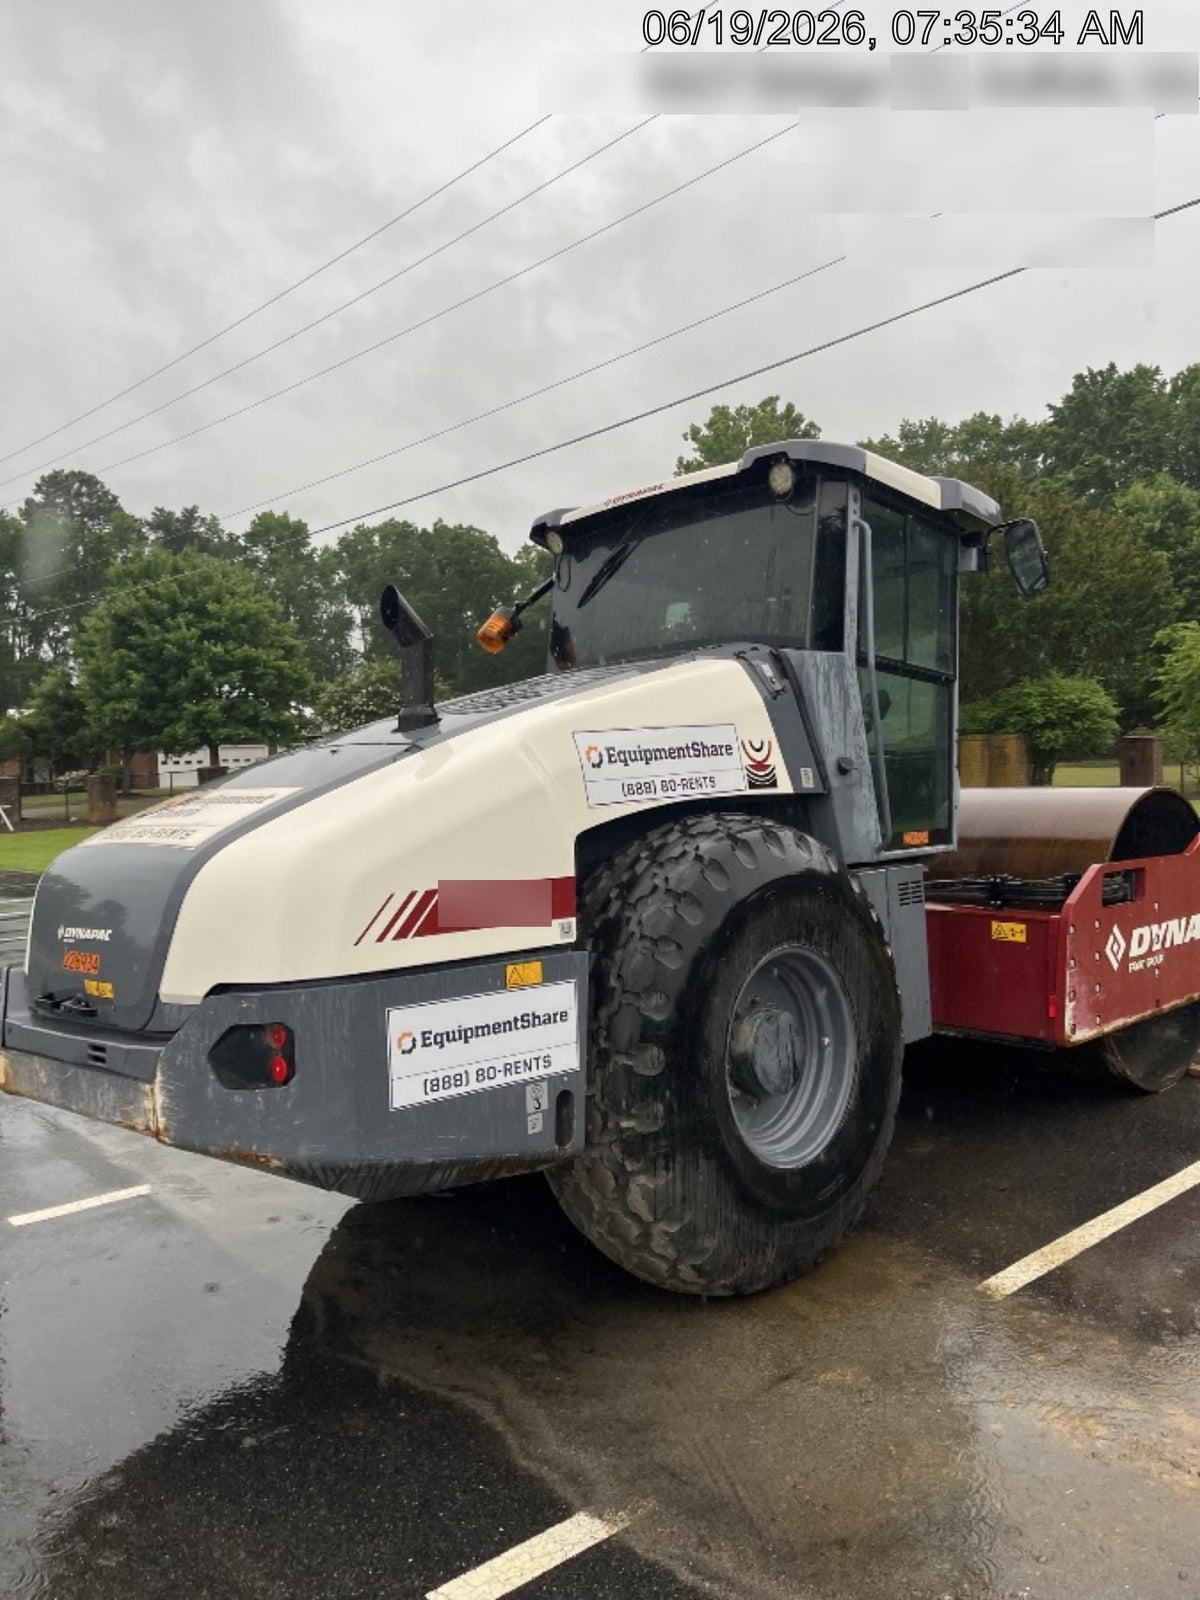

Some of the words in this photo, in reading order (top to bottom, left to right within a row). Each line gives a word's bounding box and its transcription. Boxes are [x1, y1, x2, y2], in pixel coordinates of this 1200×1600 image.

[606, 741, 733, 767] EquipmentShare
[660, 776, 716, 792] 80-RENTS
[420, 1009, 569, 1050] EquipmentShare
[423, 1070, 470, 1096] (888)
[475, 1054, 552, 1083] 80-RENTS
